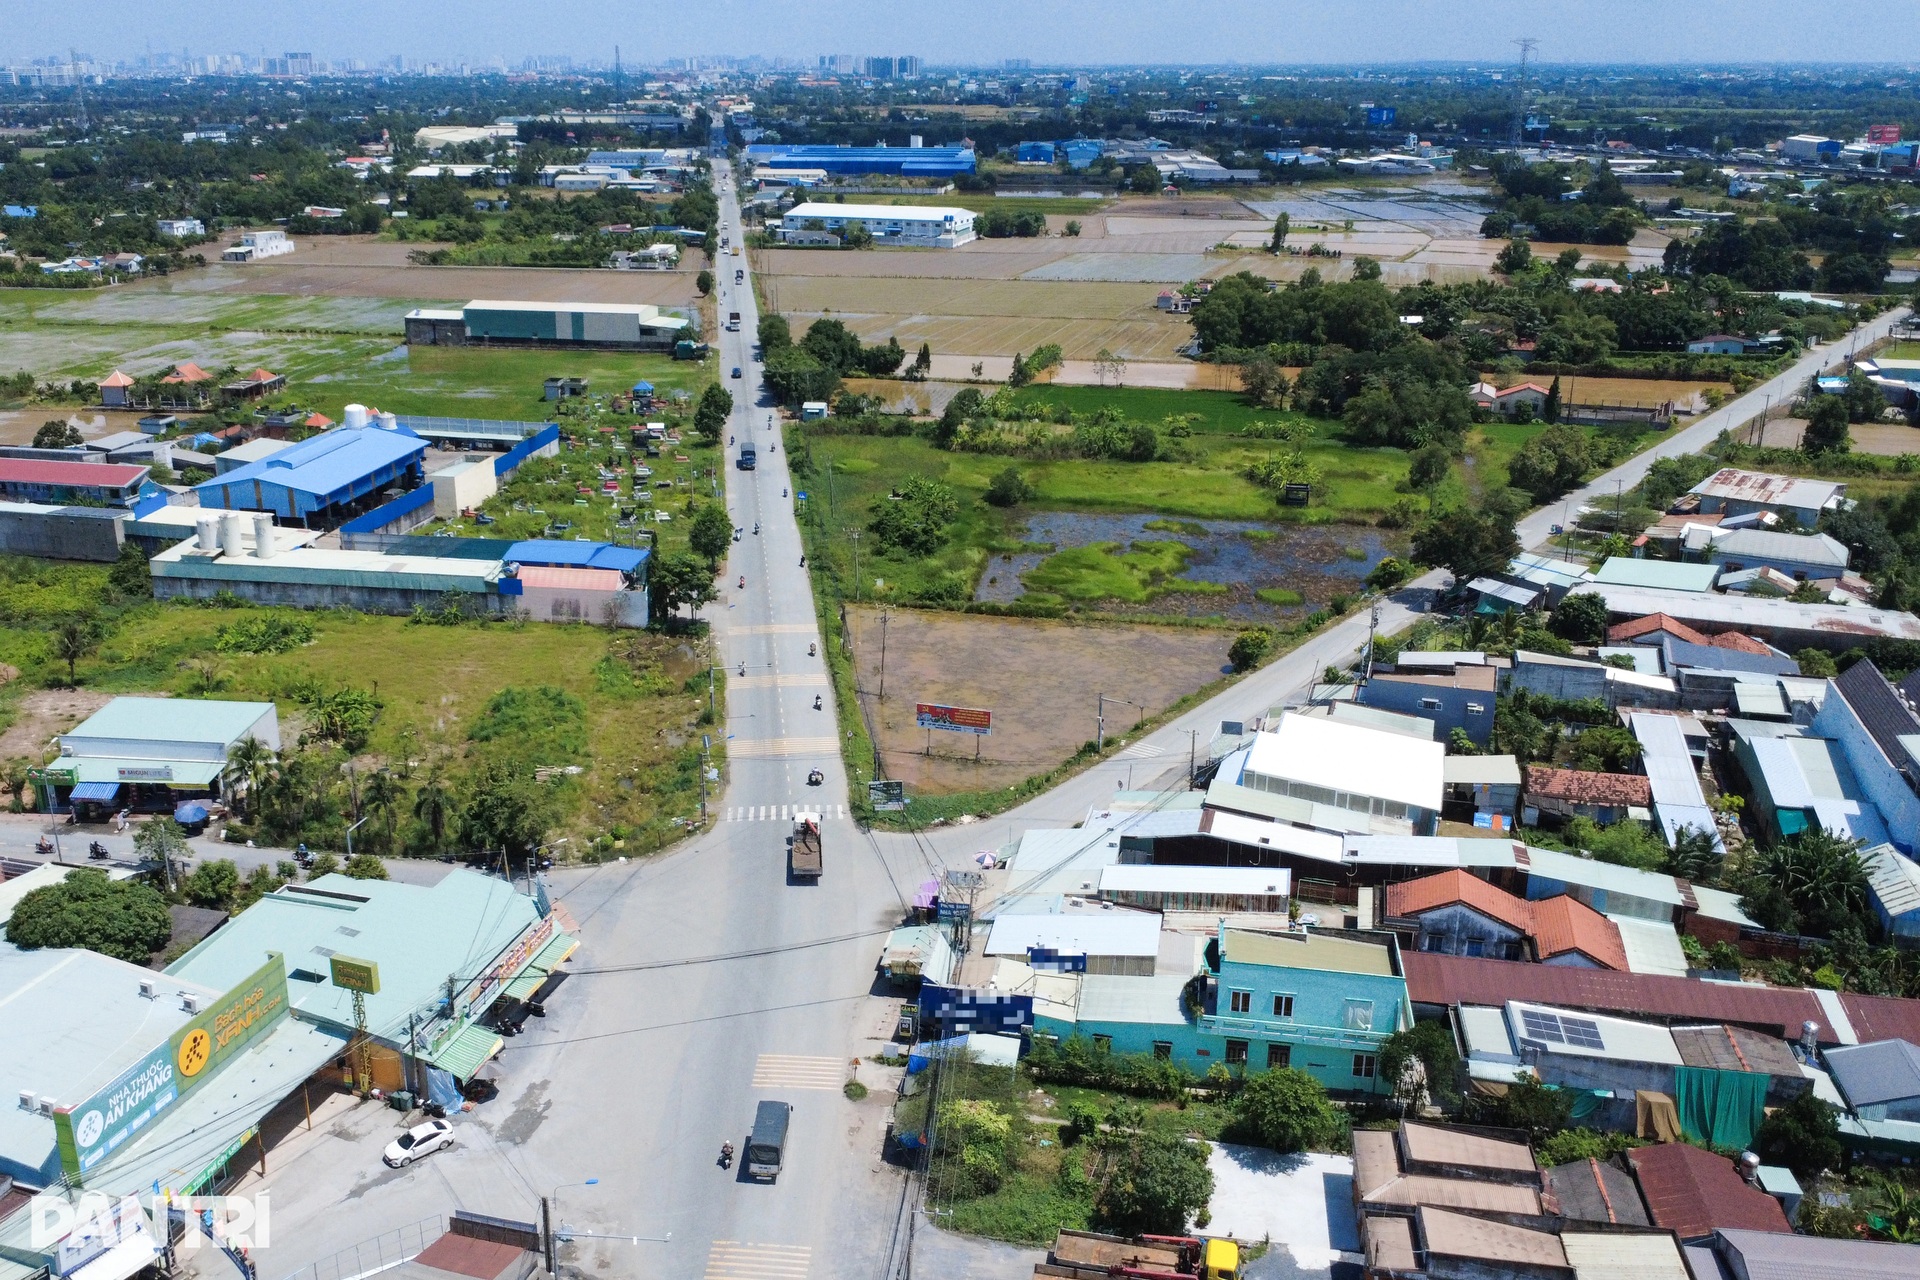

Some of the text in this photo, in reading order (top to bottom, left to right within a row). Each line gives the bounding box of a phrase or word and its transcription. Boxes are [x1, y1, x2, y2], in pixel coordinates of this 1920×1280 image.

[214, 986, 264, 1034] Bách hóa
[103, 1100, 125, 1130] AN
[126, 1064, 173, 1113] KHANG
[108, 1085, 131, 1108] NHÀ
[130, 1059, 164, 1091] THUỐC
